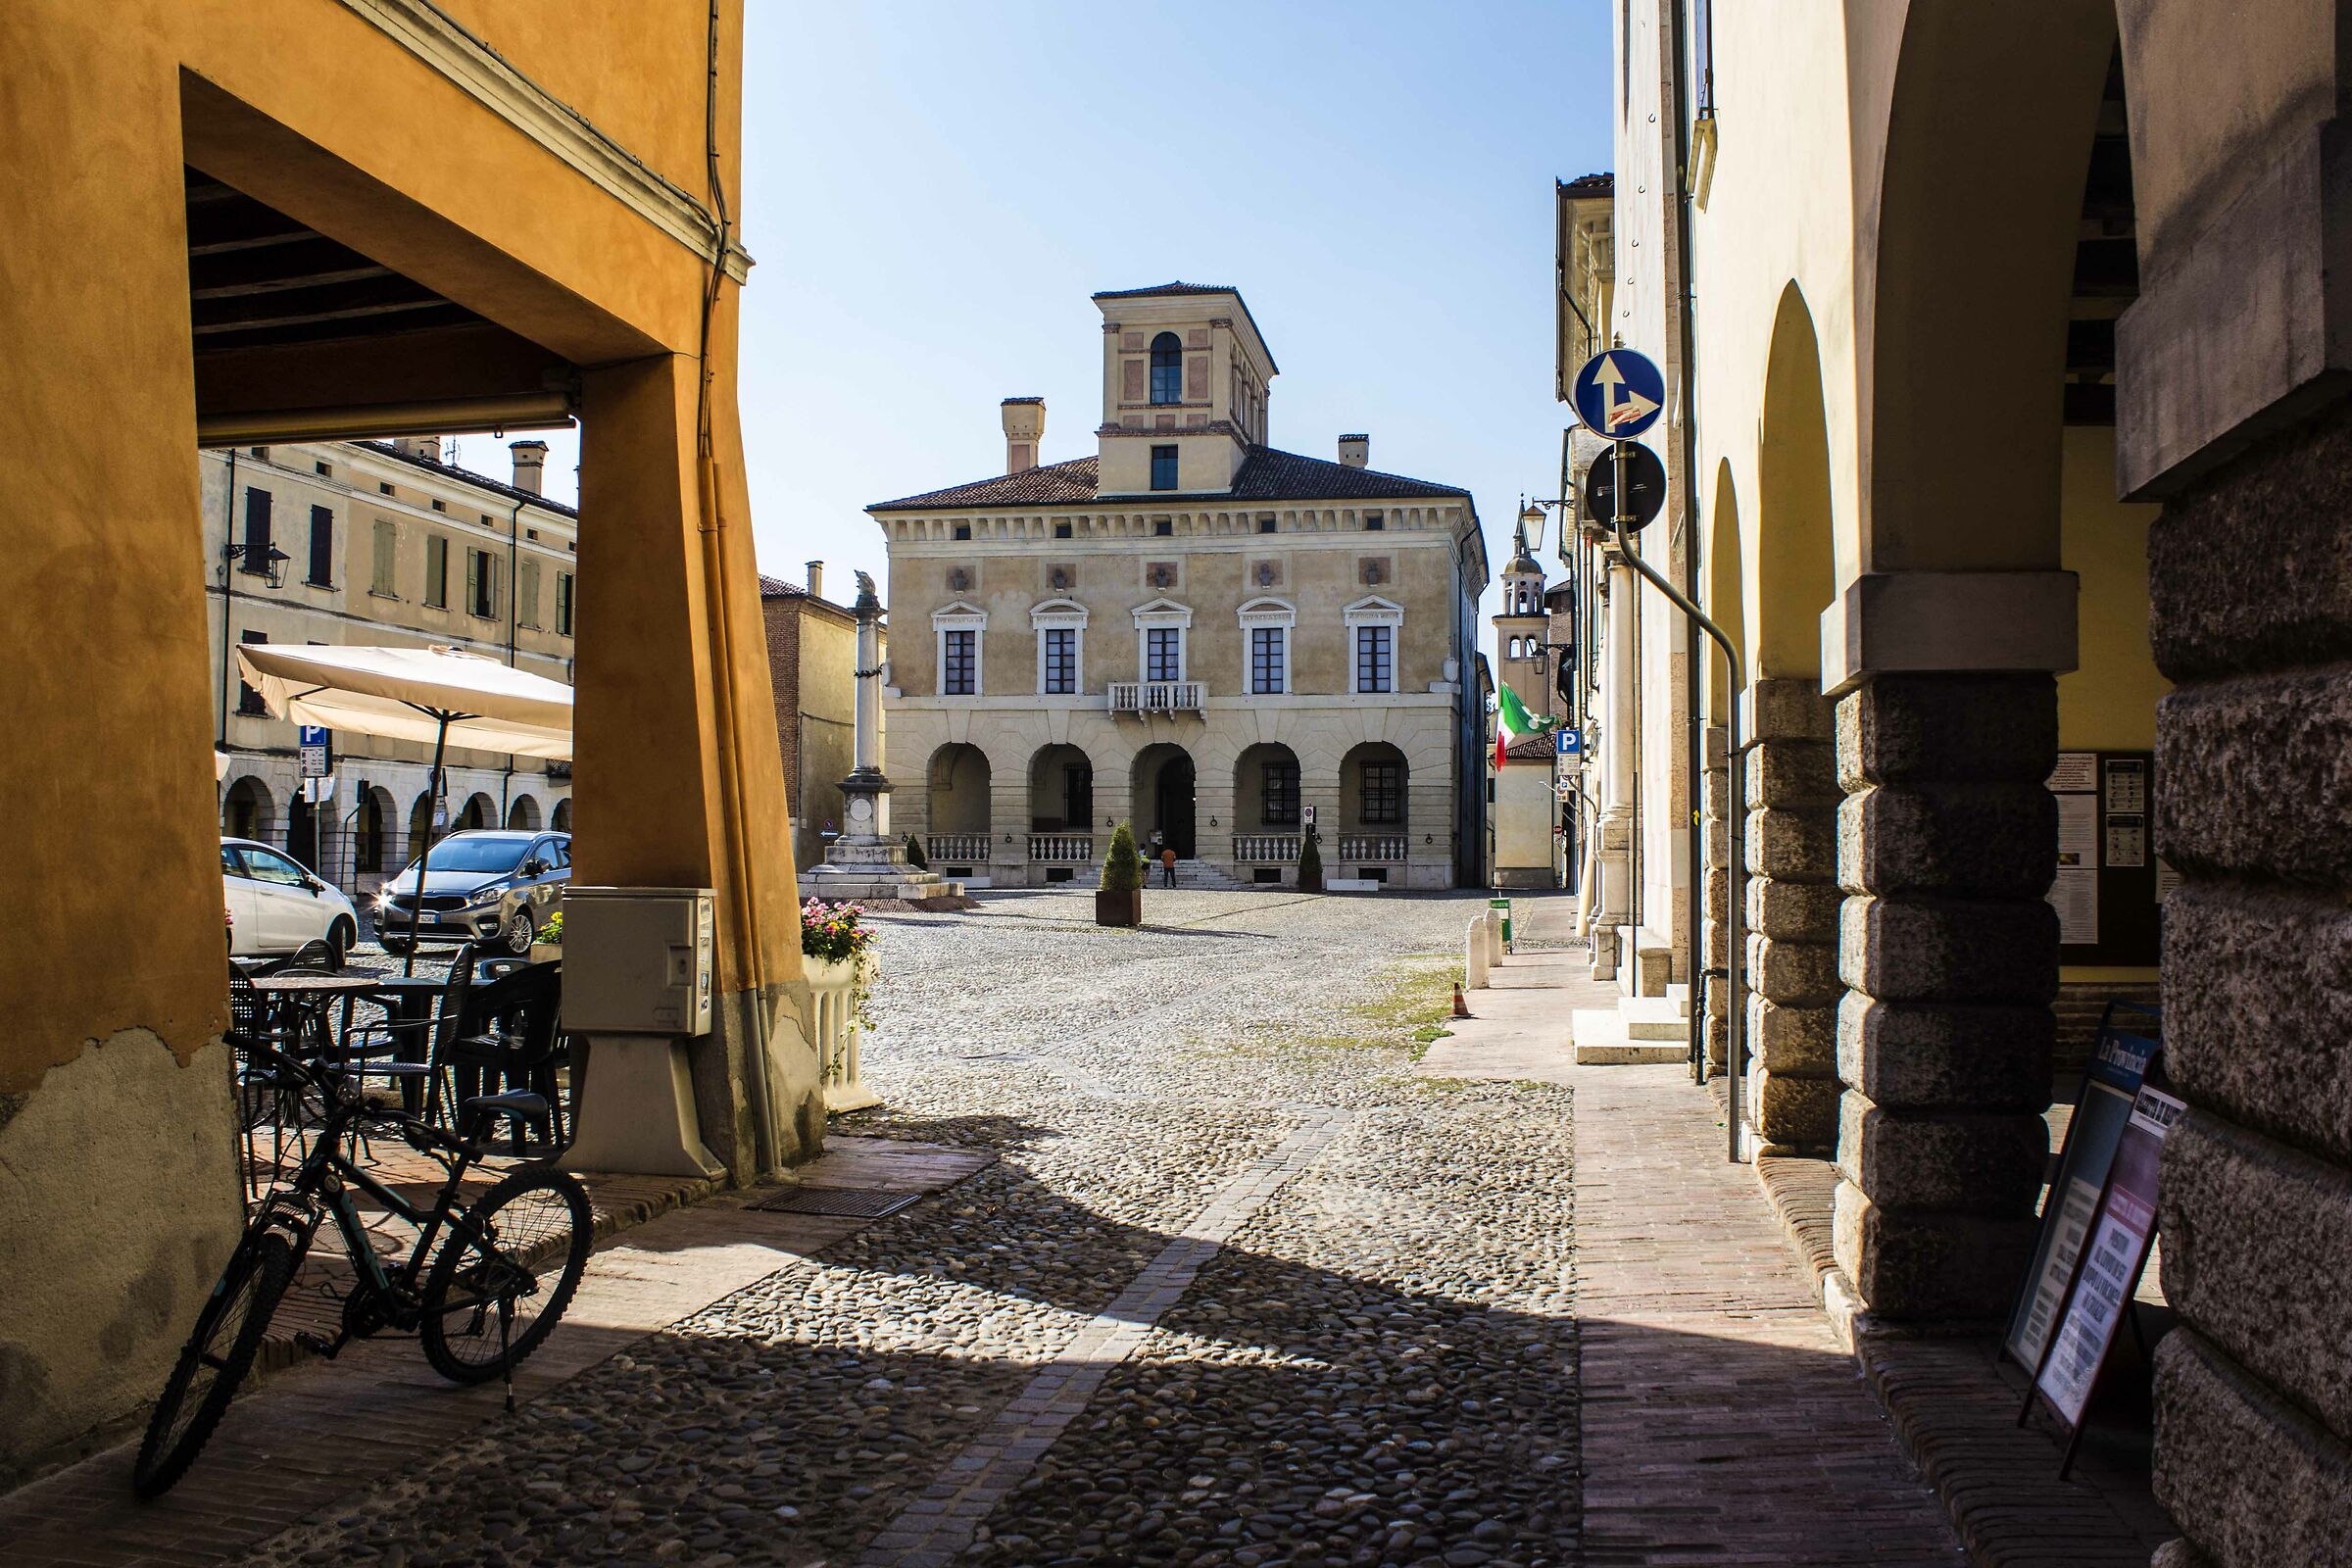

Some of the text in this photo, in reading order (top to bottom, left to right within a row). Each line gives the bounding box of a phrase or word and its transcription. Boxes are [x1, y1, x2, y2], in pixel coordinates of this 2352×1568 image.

[306, 725, 320, 742] P
[1562, 733, 1577, 751] P
[2098, 1036, 2147, 1075] La Provincia
